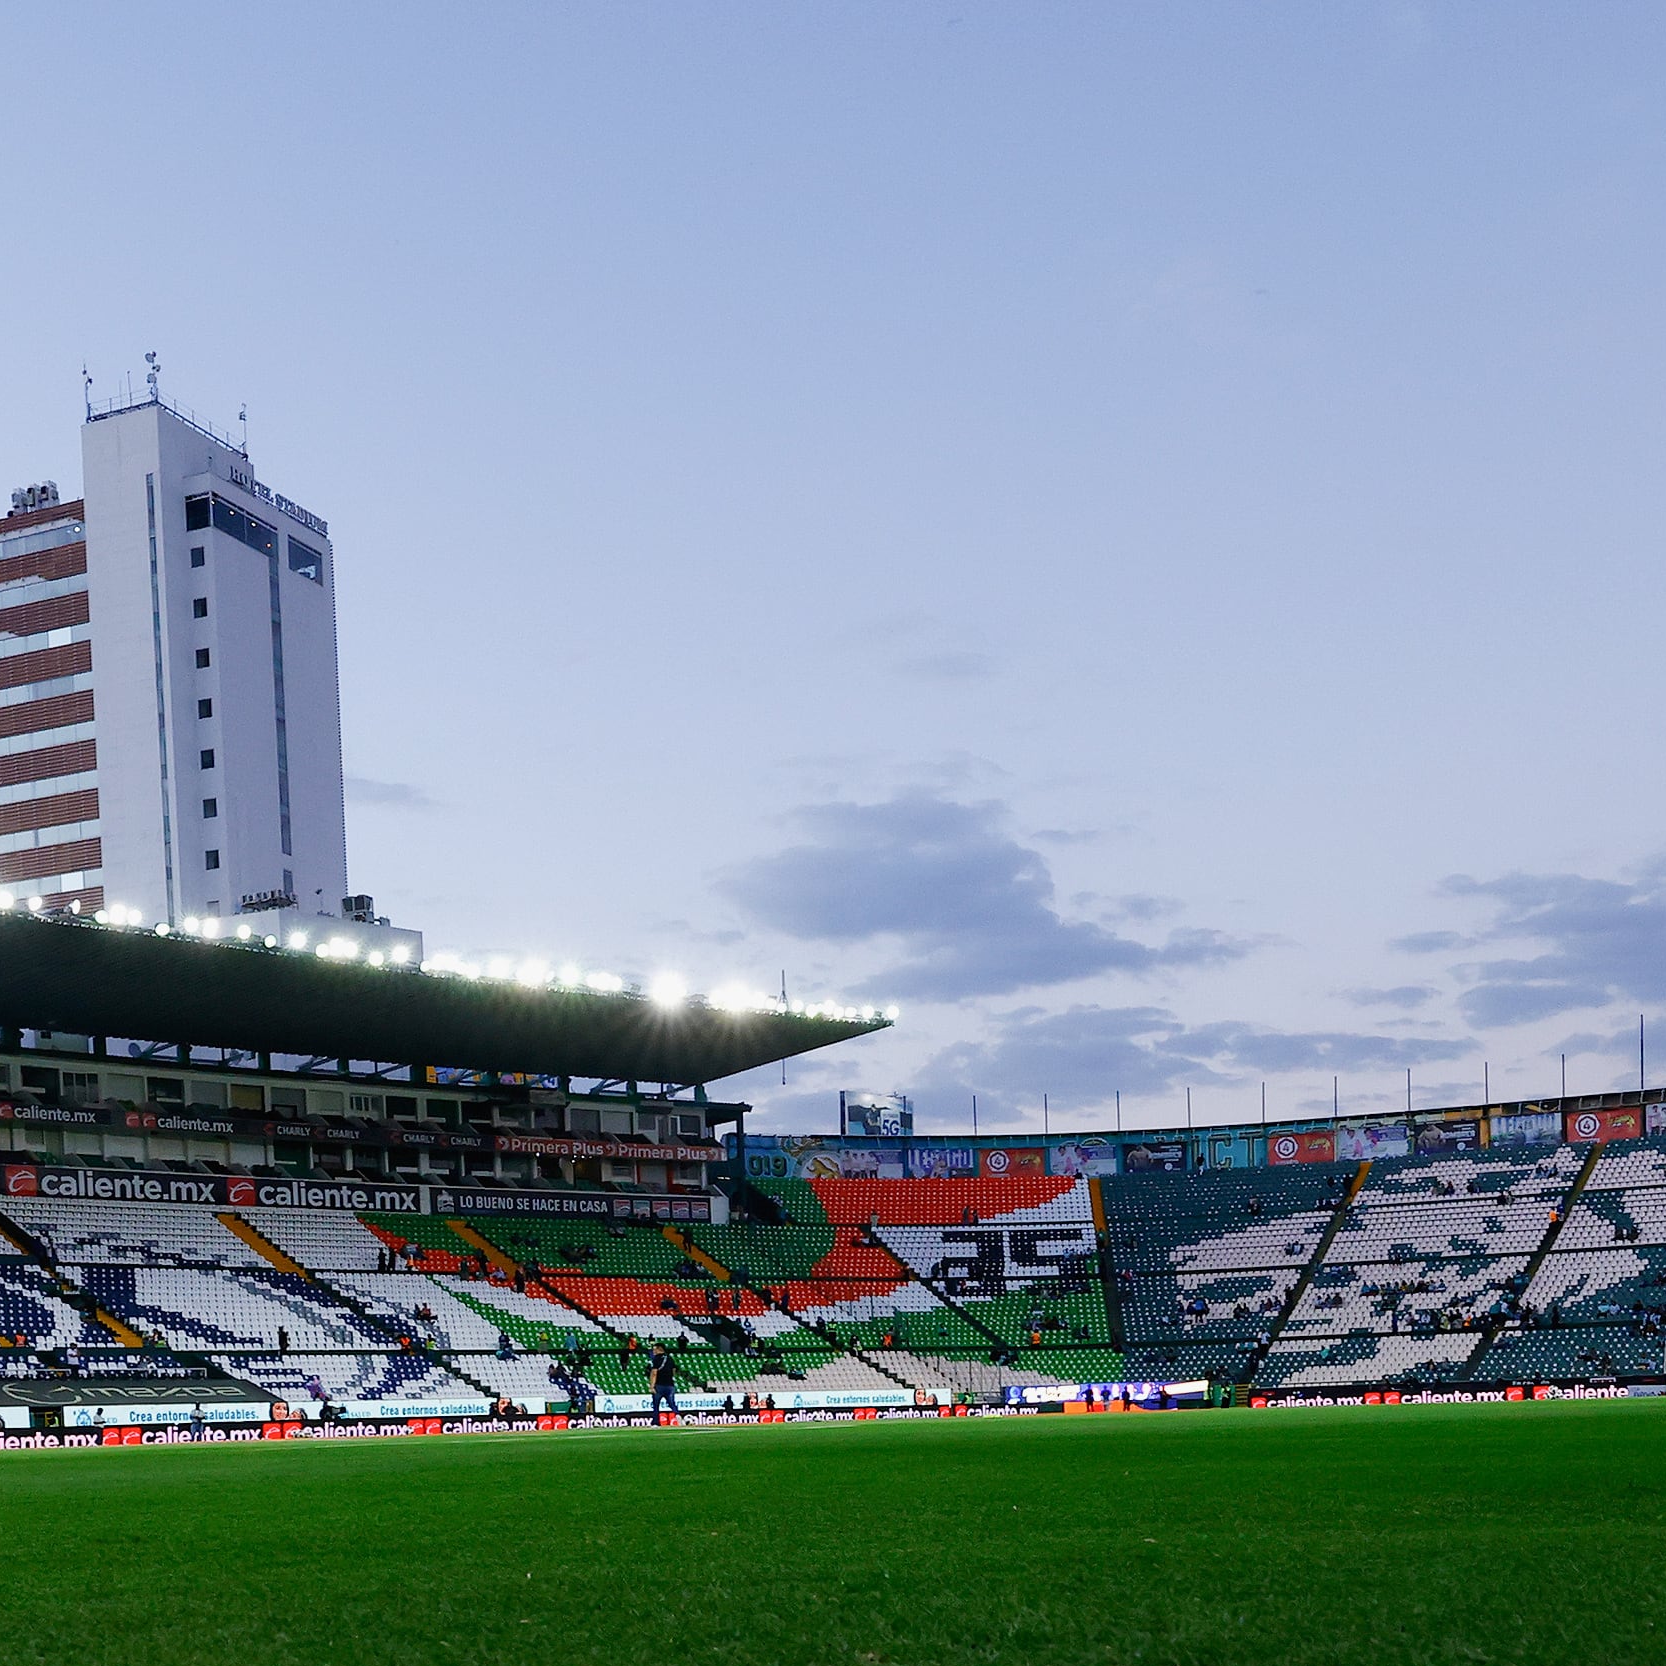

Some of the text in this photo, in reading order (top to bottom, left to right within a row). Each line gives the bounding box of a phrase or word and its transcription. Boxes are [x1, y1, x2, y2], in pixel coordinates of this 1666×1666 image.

[14, 1104, 96, 1124] caliente.mx
[158, 1114, 234, 1134] caliente.mx
[882, 1119, 900, 1136] 5G
[277, 1125, 361, 1140] CHARLY CHARLY
[402, 1132, 482, 1148] CHARLY CHARLY
[511, 1139, 605, 1156] Primera Plus
[618, 1145, 714, 1162] Primera Plus
[41, 1170, 216, 1203] caliente.mx
[259, 1181, 419, 1212] caliente.mx
[459, 1196, 474, 1209] LO
[476, 1196, 514, 1211] BUENO
[516, 1198, 531, 1211] SE
[532, 1199, 562, 1212] HACE
[563, 1200, 578, 1212] EN
[580, 1200, 609, 1213] CASA
[81, 1386, 247, 1399] mazda
[1400, 1389, 1506, 1405] caliente.mx
[130, 1411, 153, 1423] Crea
[157, 1410, 194, 1421] entorn
[204, 1409, 259, 1420] saludables.
[380, 1405, 399, 1416] Crea
[402, 1405, 438, 1416] entornos
[440, 1404, 487, 1416] saludables.
[875, 1407, 939, 1420] caliente.mx
[967, 1404, 1039, 1417] calientemx
[442, 1419, 537, 1435] caliente.mx
[568, 1415, 654, 1429] calientemx
